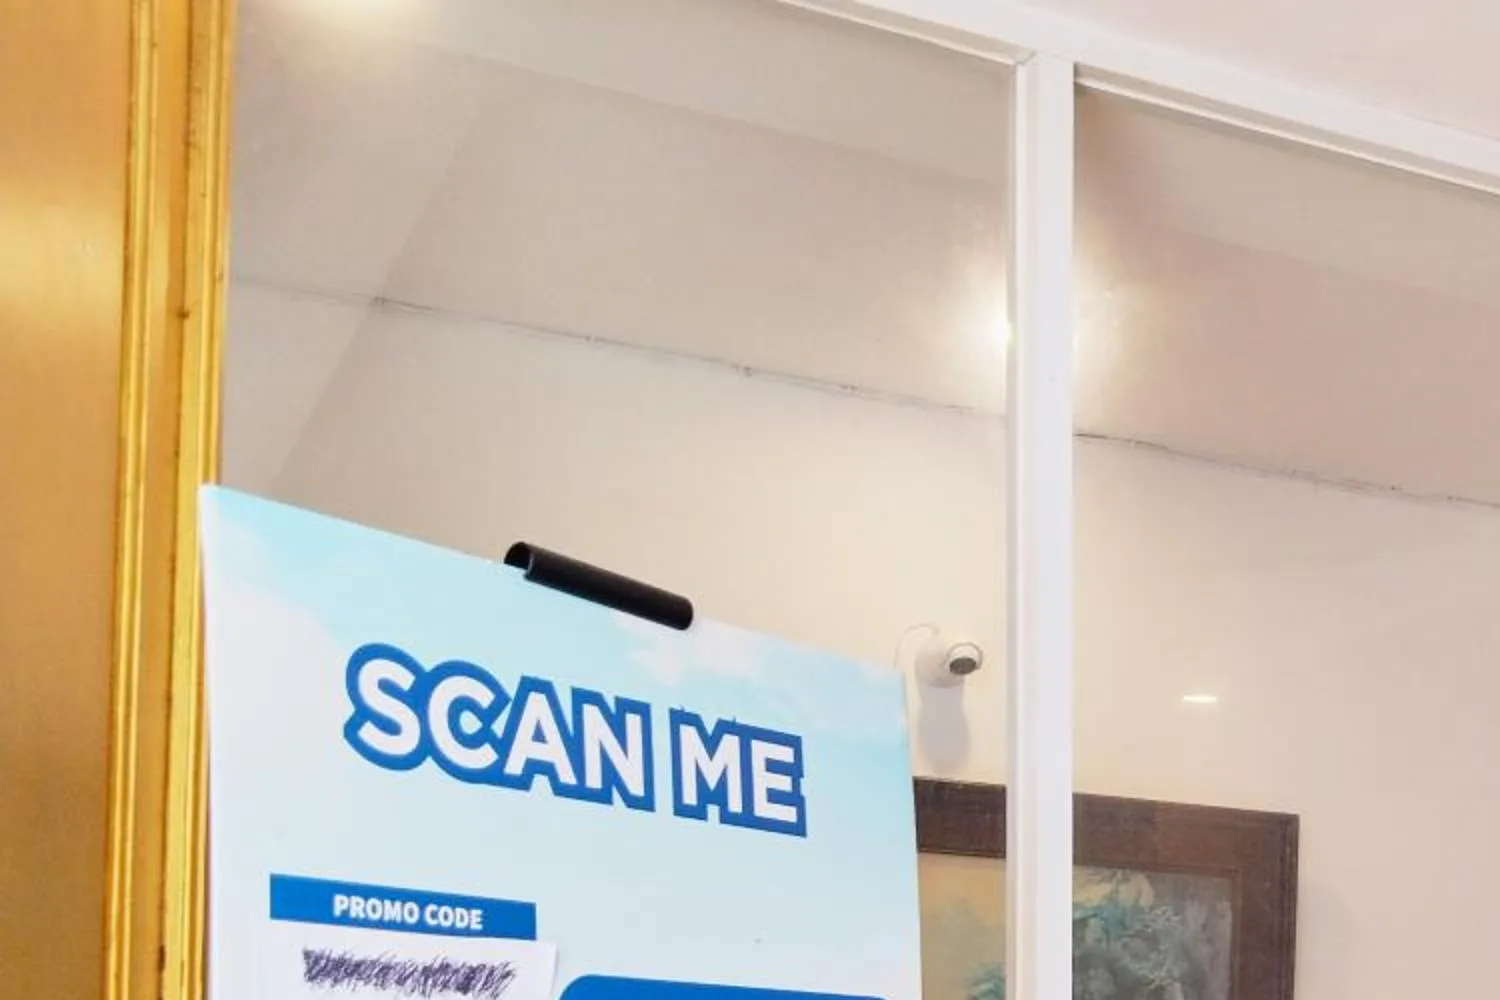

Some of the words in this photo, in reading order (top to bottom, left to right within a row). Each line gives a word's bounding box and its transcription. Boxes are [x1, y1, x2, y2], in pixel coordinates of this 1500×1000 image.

[349, 648, 650, 806] SCAN
[673, 713, 803, 832] ME
[333, 894, 419, 924] PROMO
[424, 904, 484, 930] CODE
